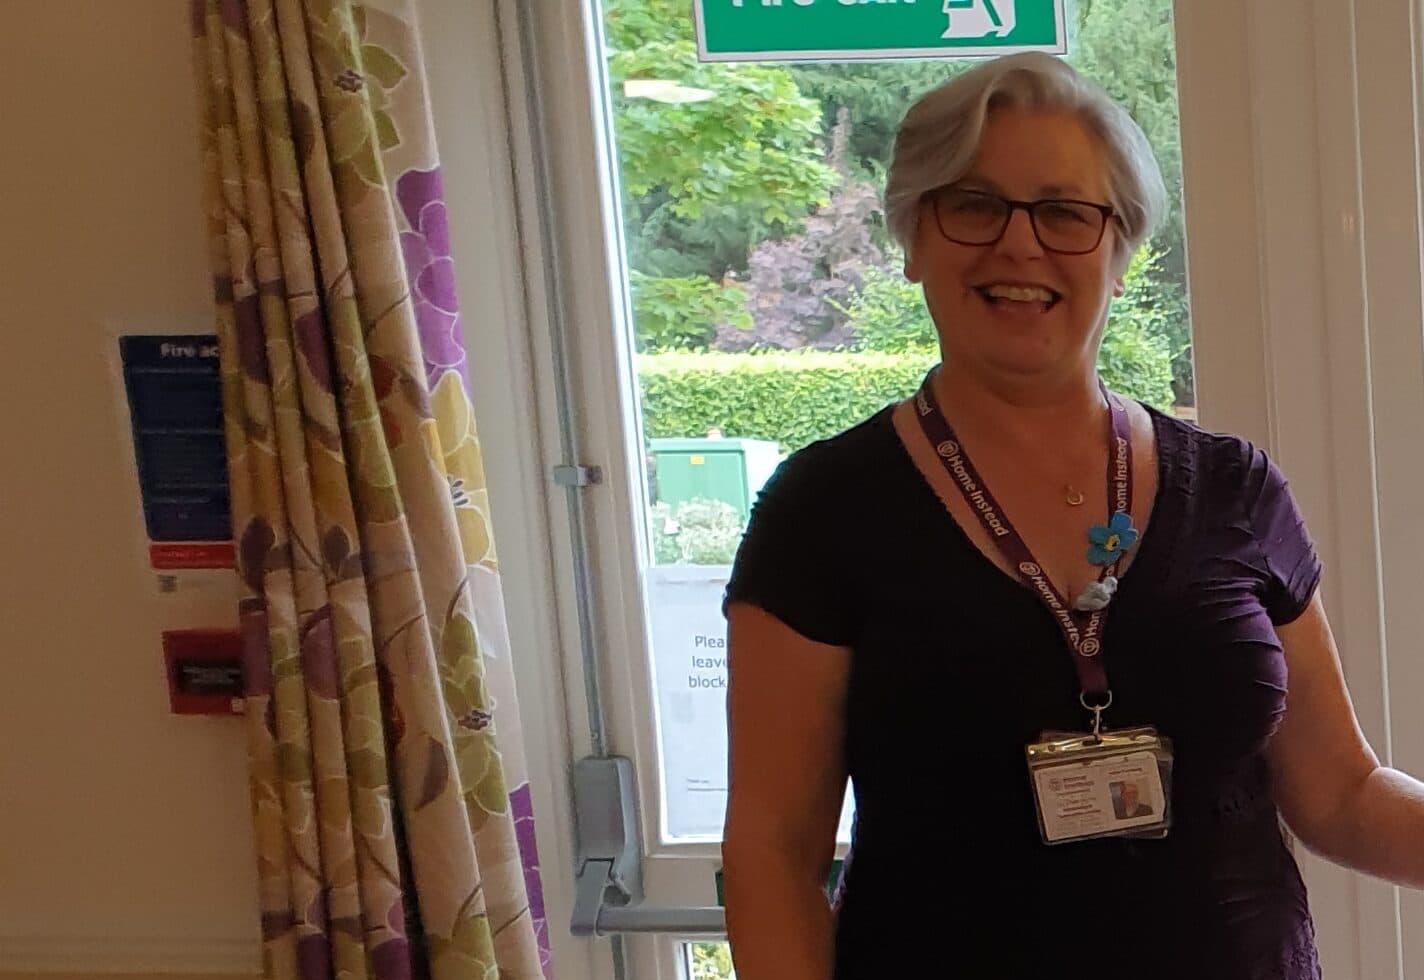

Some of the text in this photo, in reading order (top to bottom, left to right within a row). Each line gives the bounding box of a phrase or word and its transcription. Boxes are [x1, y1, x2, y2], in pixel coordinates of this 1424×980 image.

[160, 344, 219, 358] Fire ac
[947, 455, 1010, 536] Home Instead
[1116, 437, 1128, 513] ome Instead
[1031, 575, 1081, 649] Home Inste
[694, 636, 726, 648] Plea
[688, 675, 727, 688] block
